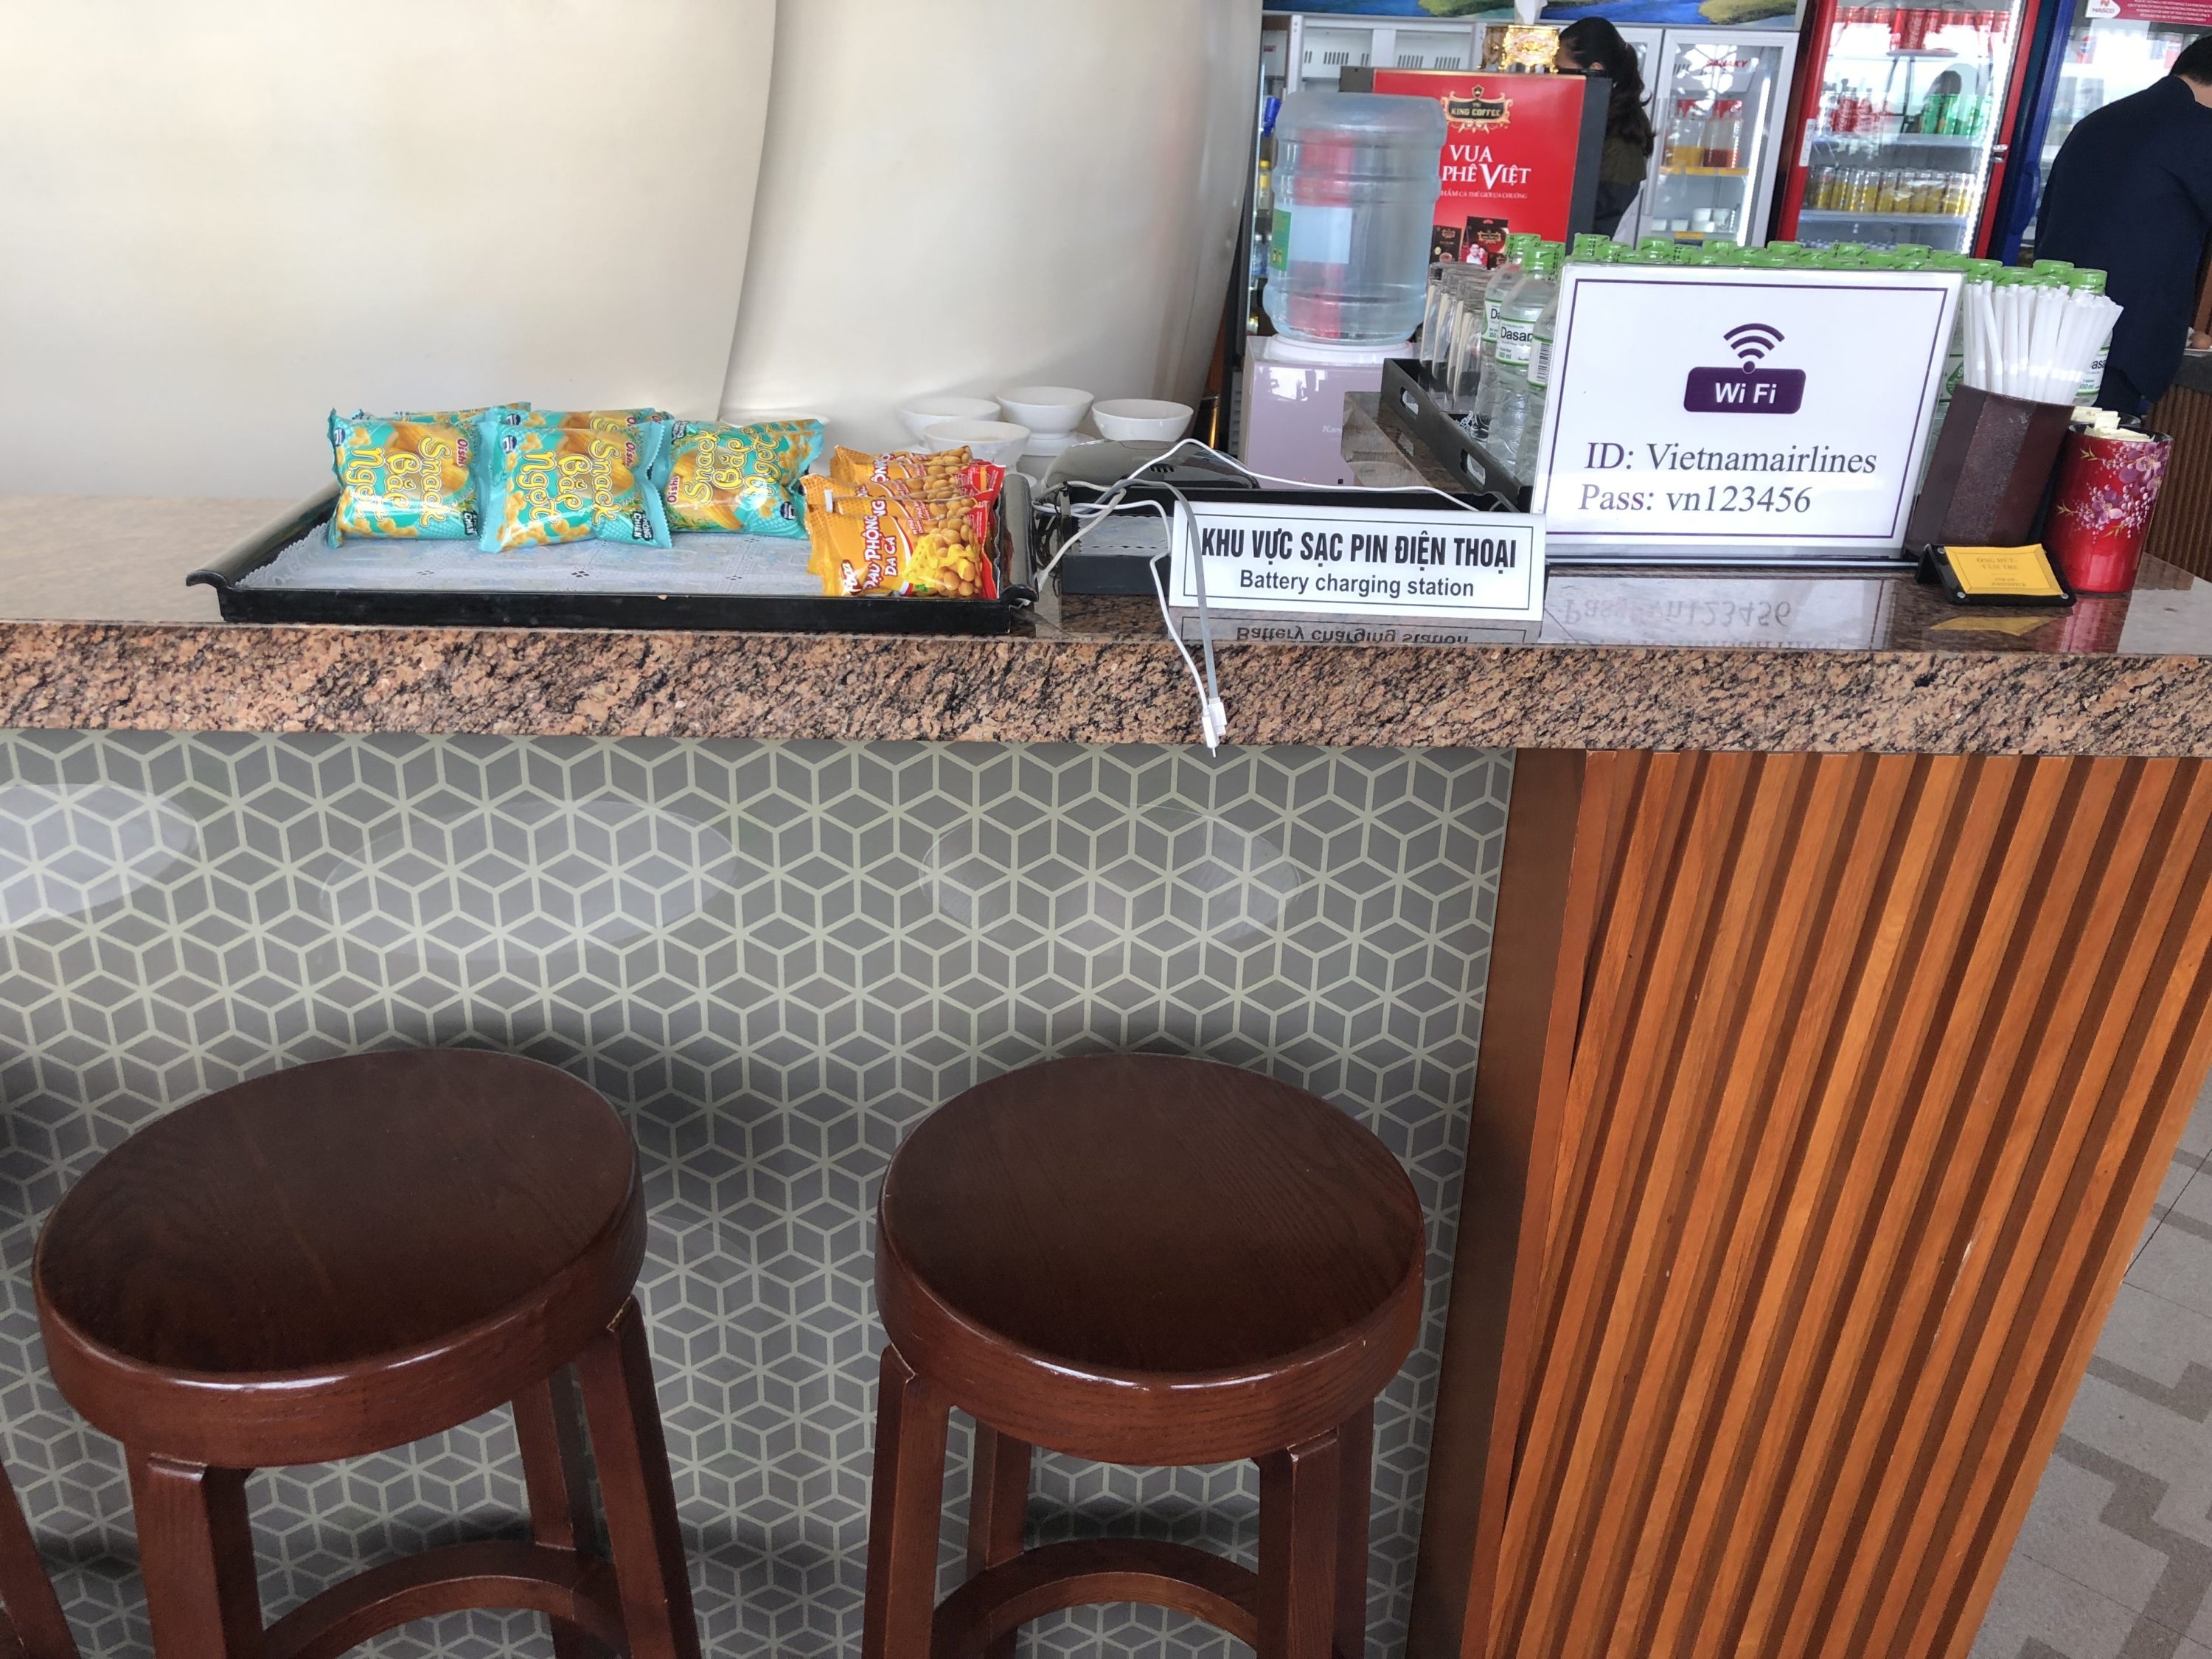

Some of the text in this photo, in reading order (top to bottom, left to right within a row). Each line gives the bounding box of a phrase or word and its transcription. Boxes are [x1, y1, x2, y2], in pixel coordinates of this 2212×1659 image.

[1450, 108, 1501, 116] KING COFFEE
[1450, 144, 1493, 162] VUA
[1441, 163, 1531, 190] PHÊ VIỆT
[1500, 326, 1534, 342] Dasan
[1715, 382, 1777, 404] Wi Fi
[684, 431, 720, 505] Snack
[1584, 442, 1877, 473] ID: Vietnamairlines
[418, 436, 452, 527] Snack
[555, 454, 591, 510] Bắp
[588, 439, 621, 525] Snack
[667, 476, 680, 504] Oishi
[1578, 483, 1813, 513] Pass: vn123456
[883, 536, 897, 577] DA CÁ
[1202, 527, 1517, 574] KHU VỰC SẠC PIN ĐIỆN THOẠI
[1240, 569, 1474, 599] Battery charging station
